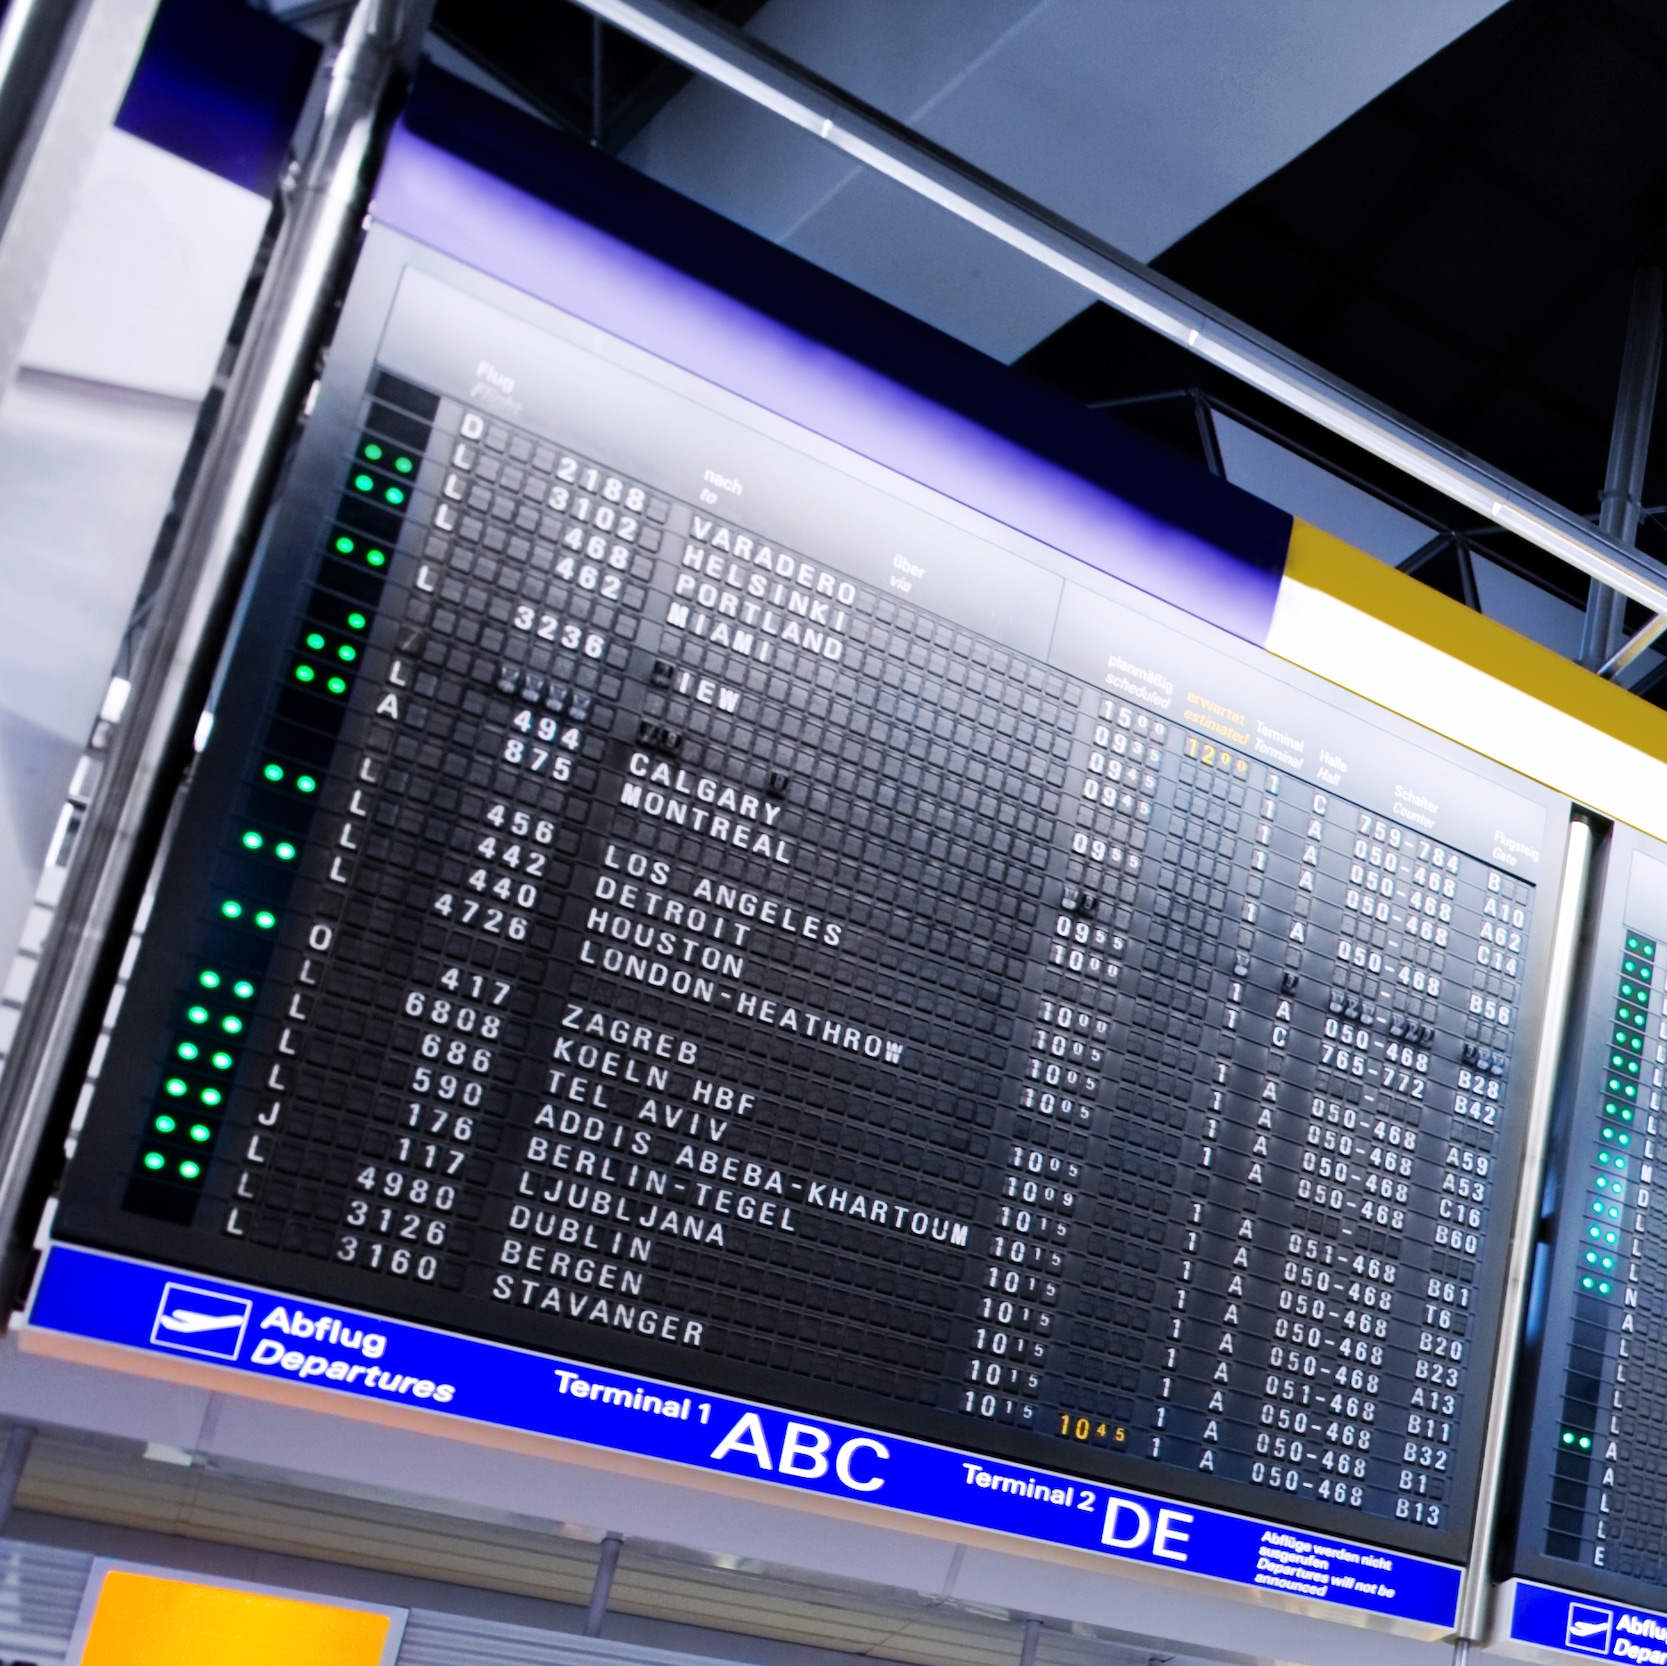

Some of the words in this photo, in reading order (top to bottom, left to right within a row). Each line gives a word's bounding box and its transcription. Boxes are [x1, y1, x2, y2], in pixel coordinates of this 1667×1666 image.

[476, 360, 515, 394] Flug
[700, 487, 718, 505] to
[704, 468, 744, 496] nach
[890, 575, 912, 592] via
[892, 554, 926, 578] über
[514, 606, 604, 658] 3236
[556, 557, 621, 599] 462
[667, 602, 773, 661] MIAMI
[558, 457, 645, 510] 2188
[694, 516, 856, 604] VARADERO
[1358, 813, 1461, 876] 759-784
[1106, 672, 1171, 710] scheduled
[1108, 654, 1174, 696] planmäßig
[549, 485, 637, 539] 3102
[684, 544, 848, 631] HELSINKI
[1485, 896, 1524, 927] A10
[1184, 708, 1250, 746] estimated
[1187, 692, 1246, 727] erwartet
[1256, 719, 1304, 752] Terminal
[514, 710, 579, 750] 494
[630, 753, 780, 824] CALGARY
[564, 528, 629, 568] 468
[676, 572, 842, 660] PORTLAND
[1480, 923, 1520, 953] A62
[1254, 739, 1304, 770] Terminal
[1320, 749, 1348, 773] Halle
[504, 740, 571, 780] 875
[621, 783, 794, 864] MONTREAL
[1317, 768, 1341, 786] Hall
[1394, 784, 1440, 814] Schalter
[1392, 802, 1436, 829] Counter
[487, 805, 554, 843] 456
[605, 845, 670, 884] LOS
[694, 879, 841, 945] ANGELES
[1492, 847, 1518, 866] Gate
[478, 837, 545, 876] 442
[596, 876, 750, 945] DETROIT
[469, 870, 536, 907] 440
[588, 908, 743, 978] HOUSTON
[434, 894, 527, 940] 4726
[581, 940, 903, 1063] LONDON-HEATHROW
[441, 968, 510, 1004] 417
[562, 1004, 697, 1064] ZAGREB
[406, 992, 500, 1038] 6808
[554, 1037, 668, 1090] KOELN
[693, 1080, 754, 1114] HBF
[422, 1034, 490, 1072] 686
[550, 1070, 606, 1108] TEL
[639, 1100, 727, 1141] AVIV
[410, 1104, 472, 1140] 176
[528, 1137, 794, 1231] BERLIN-TEGEL
[413, 1068, 482, 1106] 590
[535, 1104, 650, 1154] ADDIS
[676, 1146, 968, 1246] ABEBA-KHARTOUM
[358, 1167, 454, 1209] 4980
[510, 1205, 651, 1261] DUBLIN
[400, 1138, 464, 1174] 117
[520, 1172, 723, 1246] LJUBLJANA
[260, 1306, 386, 1359] Abflug
[347, 1201, 446, 1244] 3126
[501, 1240, 642, 1294] BERGEN
[1404, 1442, 1446, 1470] B32
[250, 1338, 456, 1403] Departures
[338, 1236, 436, 1280] 3160
[493, 1275, 702, 1345] STAVANGER
[1396, 1501, 1440, 1526] B13
[554, 1369, 689, 1420] Terminal
[698, 1403, 712, 1424] 1
[710, 1412, 891, 1492] ABC
[962, 1462, 1074, 1508] Terminal
[1076, 1490, 1095, 1512] 2
[1101, 1497, 1194, 1562] DE
[1256, 1558, 1329, 1584] Departures
[1331, 1576, 1355, 1589] will
[1355, 1582, 1377, 1595] not
[1378, 1586, 1396, 1598] be
[1259, 1546, 1329, 1570] ausgerufen
[1261, 1531, 1312, 1552] Abflüge
[1314, 1546, 1359, 1564] werden
[1361, 1555, 1392, 1572] nicht
[1254, 1573, 1328, 1597] announced
